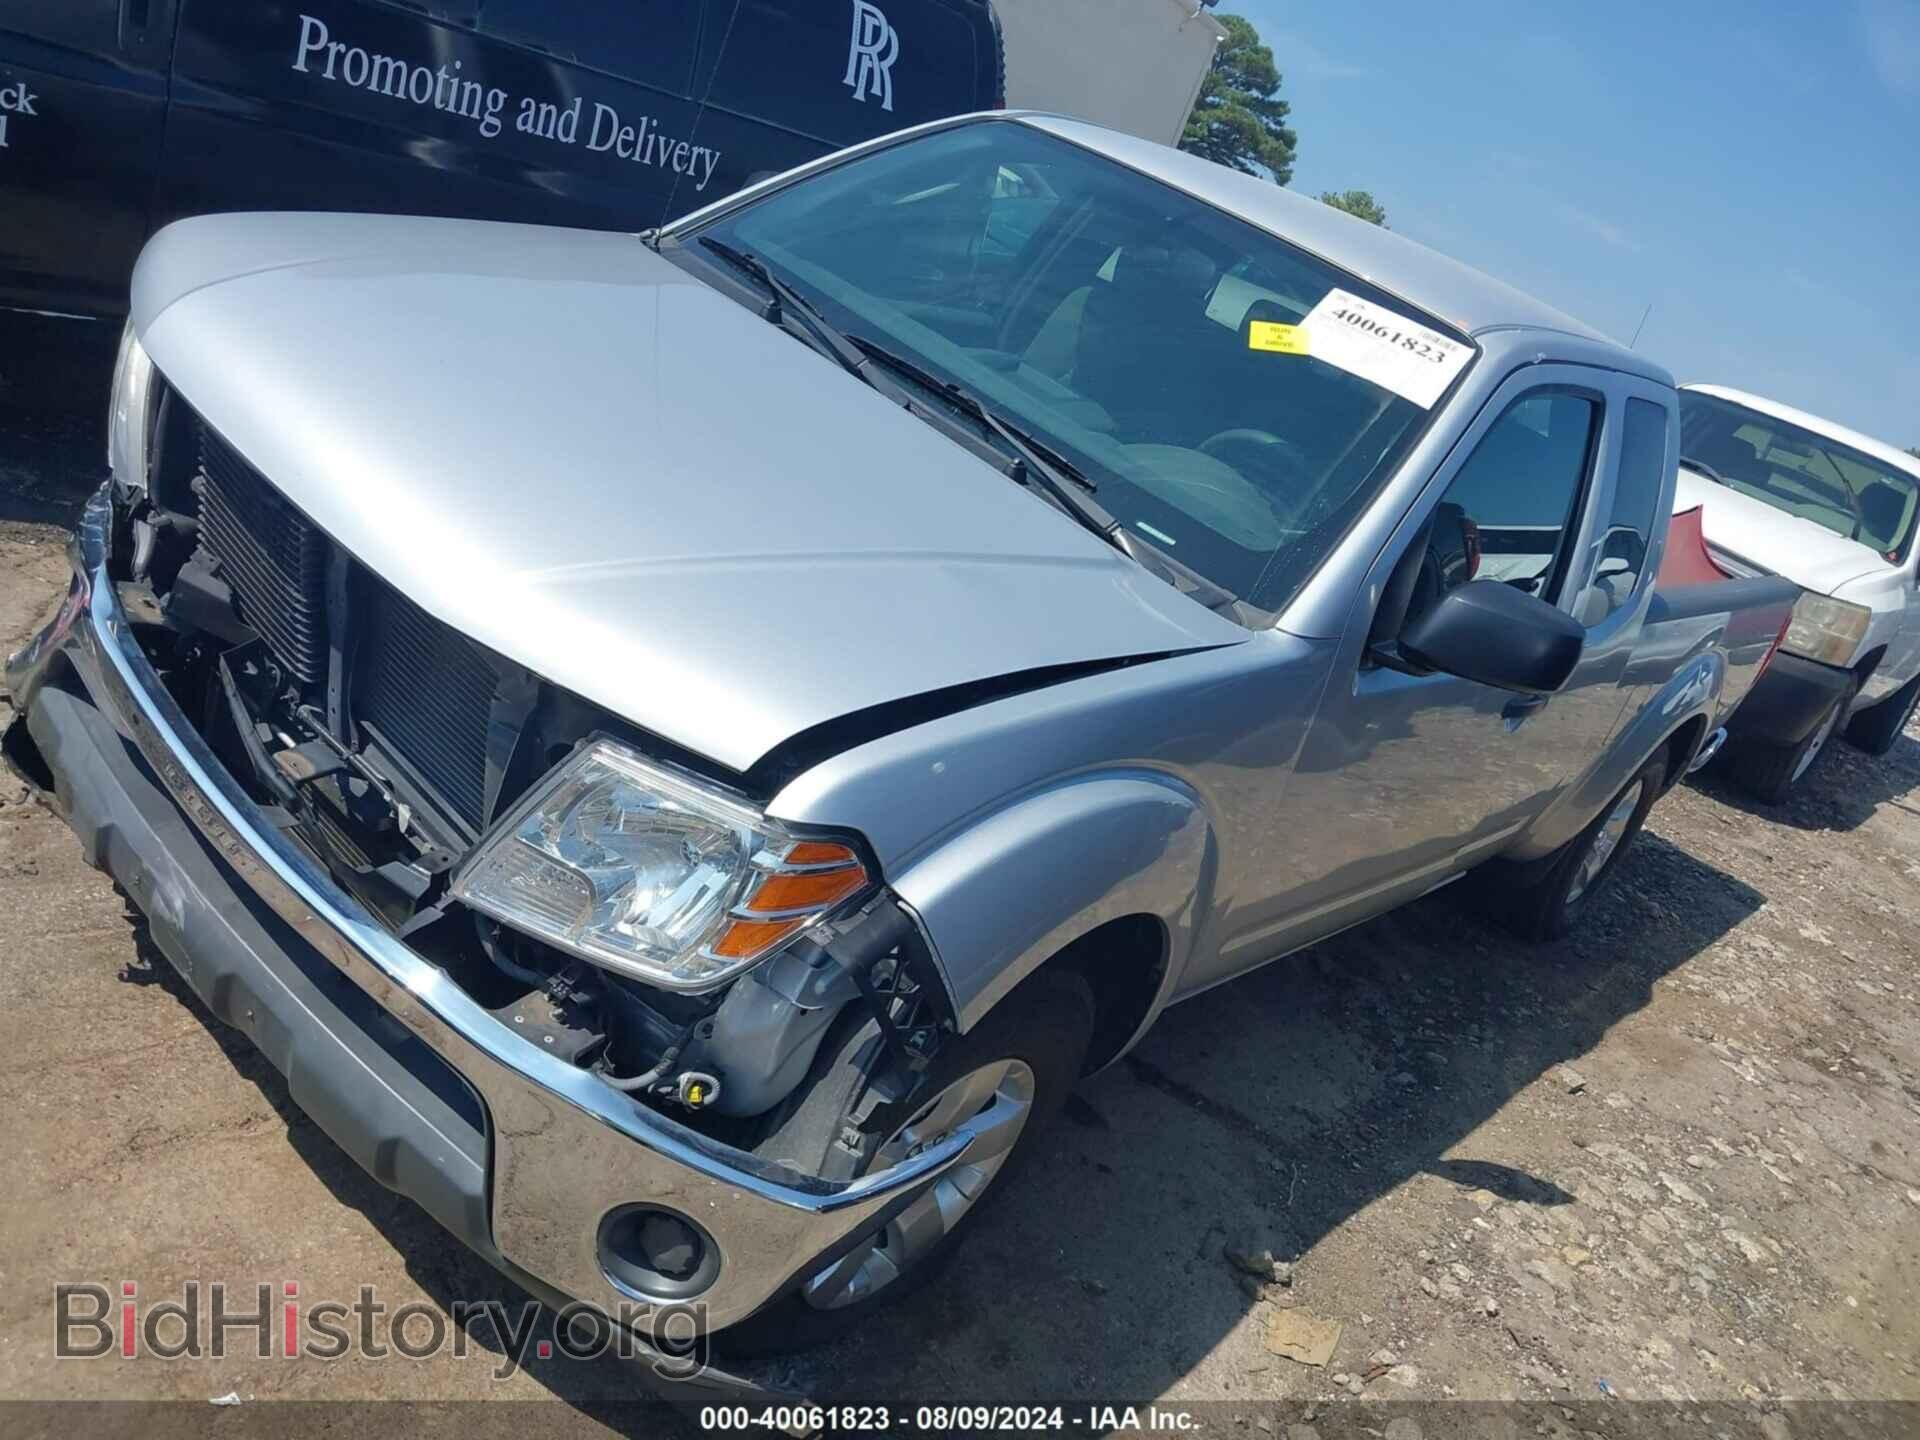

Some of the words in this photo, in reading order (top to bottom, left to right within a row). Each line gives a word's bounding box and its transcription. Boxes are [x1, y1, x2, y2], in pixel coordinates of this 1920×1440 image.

[292, 16, 507, 137] Promoting
[516, 97, 582, 145] and
[587, 102, 720, 190] Delivery
[1332, 308, 1446, 364] 40061823
